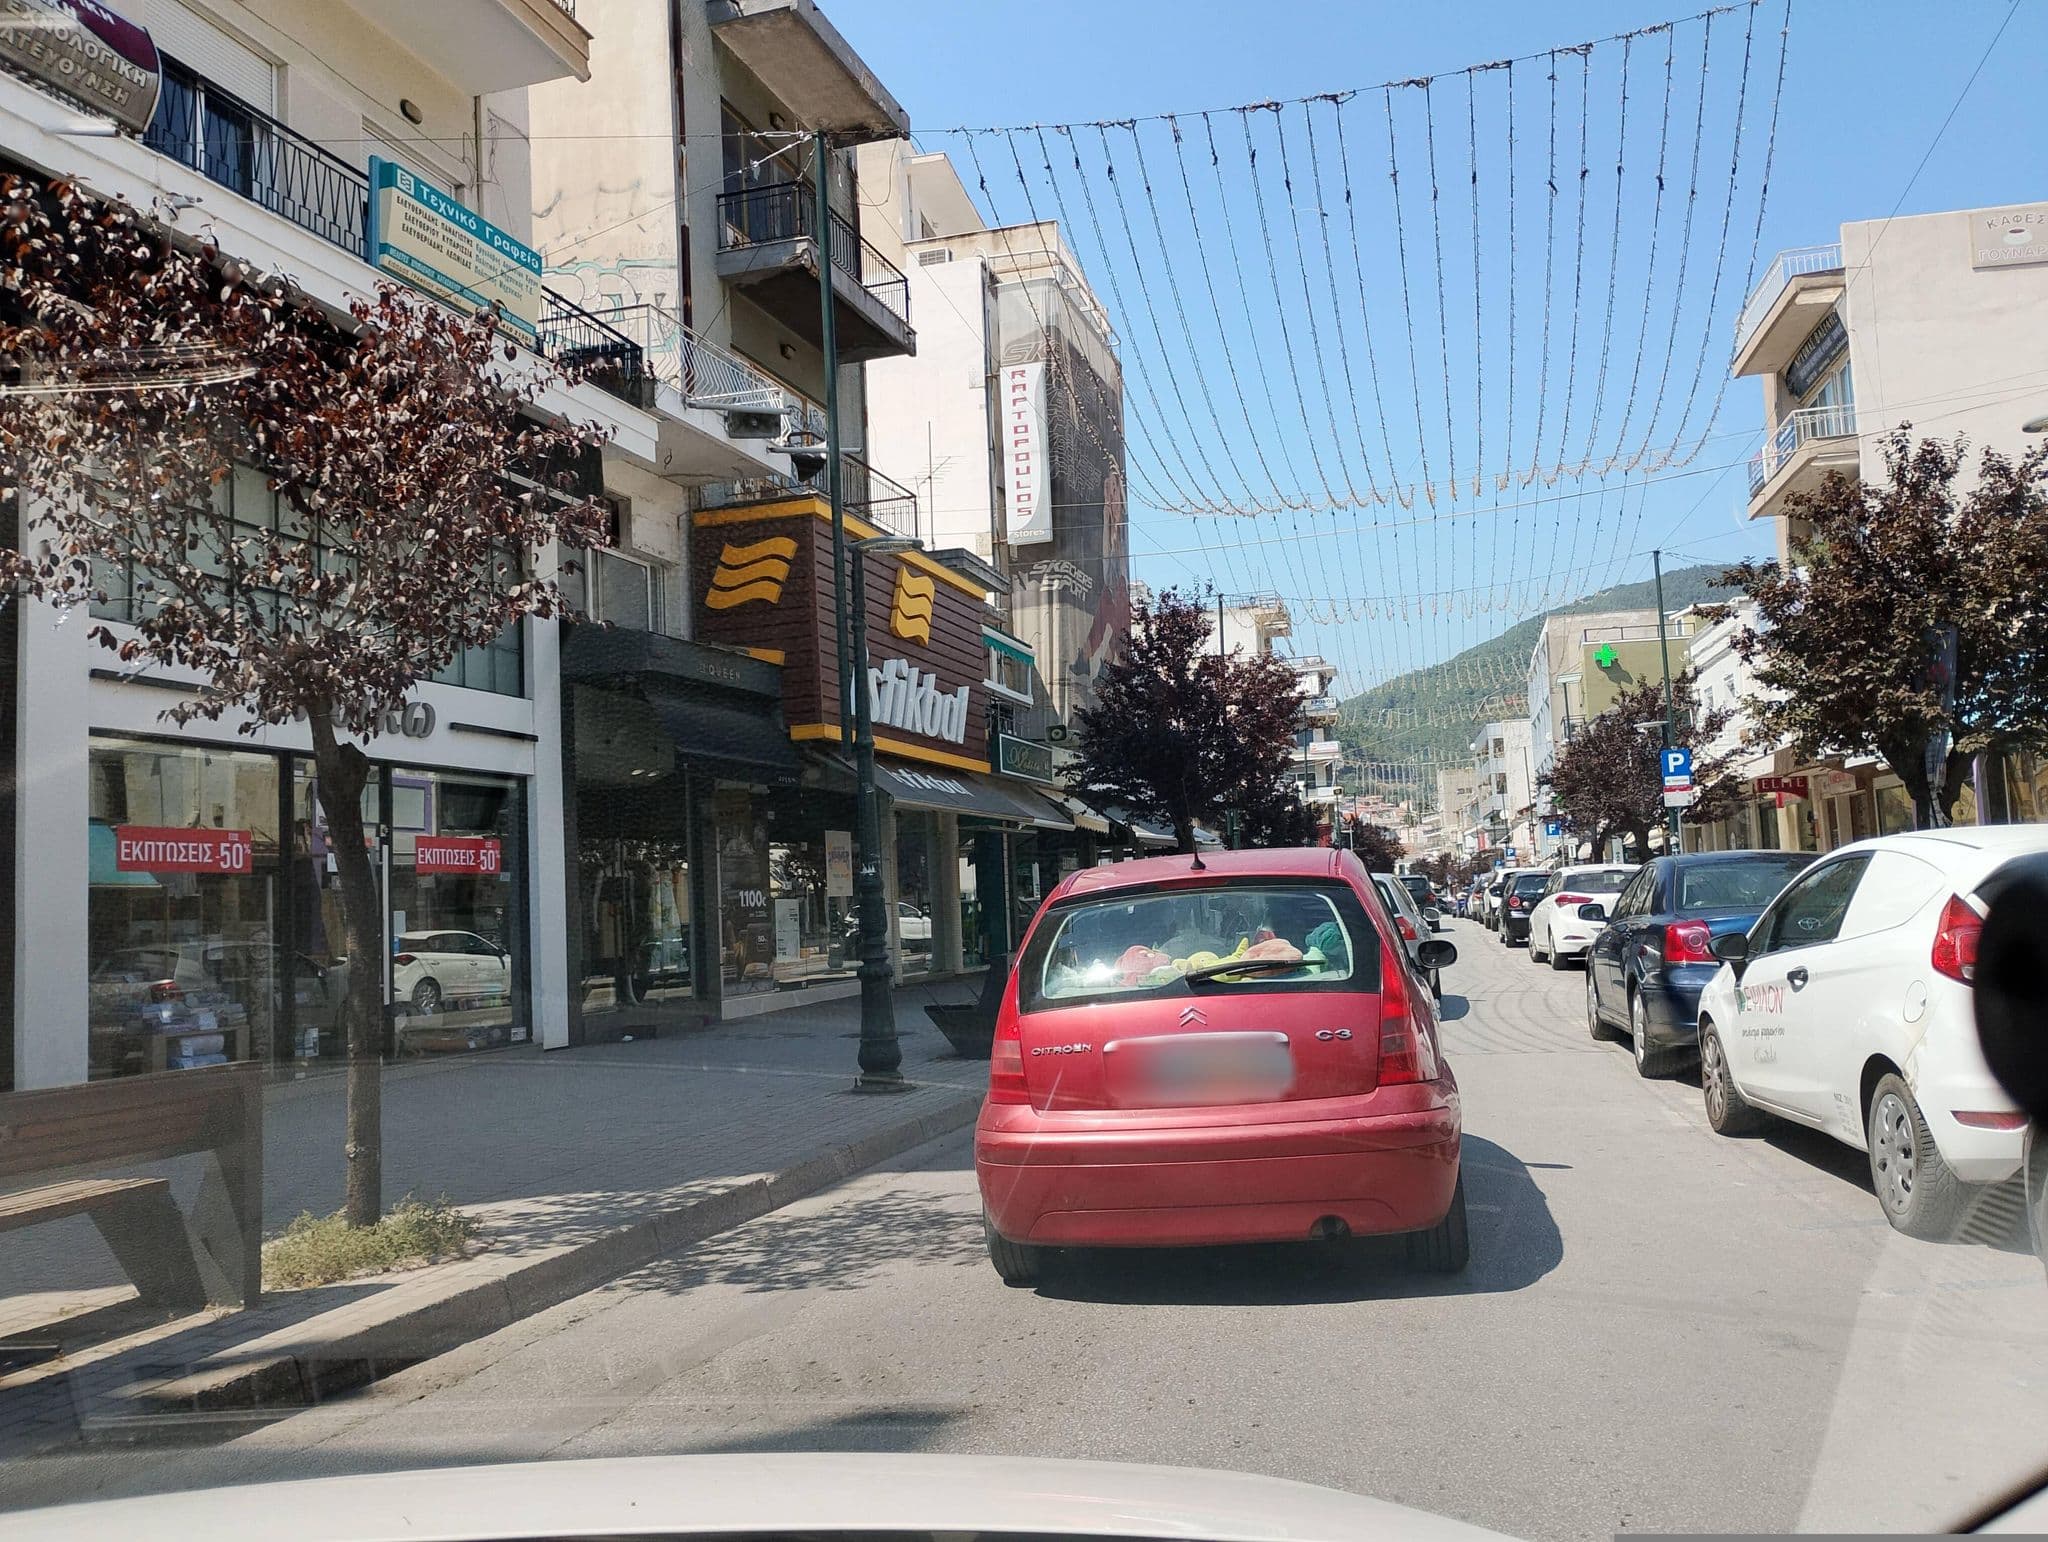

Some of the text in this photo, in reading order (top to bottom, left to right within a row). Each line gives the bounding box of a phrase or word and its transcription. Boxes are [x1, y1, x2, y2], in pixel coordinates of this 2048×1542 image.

[420, 184, 478, 231] Τεχνικό
[485, 226, 539, 269] Γραφείο
[1986, 213, 2047, 229] ΚΑΦΕΣ
[1011, 369, 1033, 517] RAPTOPOULOS
[1014, 529, 1045, 540] stores
[850, 646, 970, 745] stikbal
[1668, 753, 1685, 773] P
[121, 841, 213, 863] ΕΚΠΤΩΣΕΙΣ
[418, 848, 475, 866] ΕΚΠΤΩΣΕΙΣ
[1315, 1029, 1352, 1040] C3
